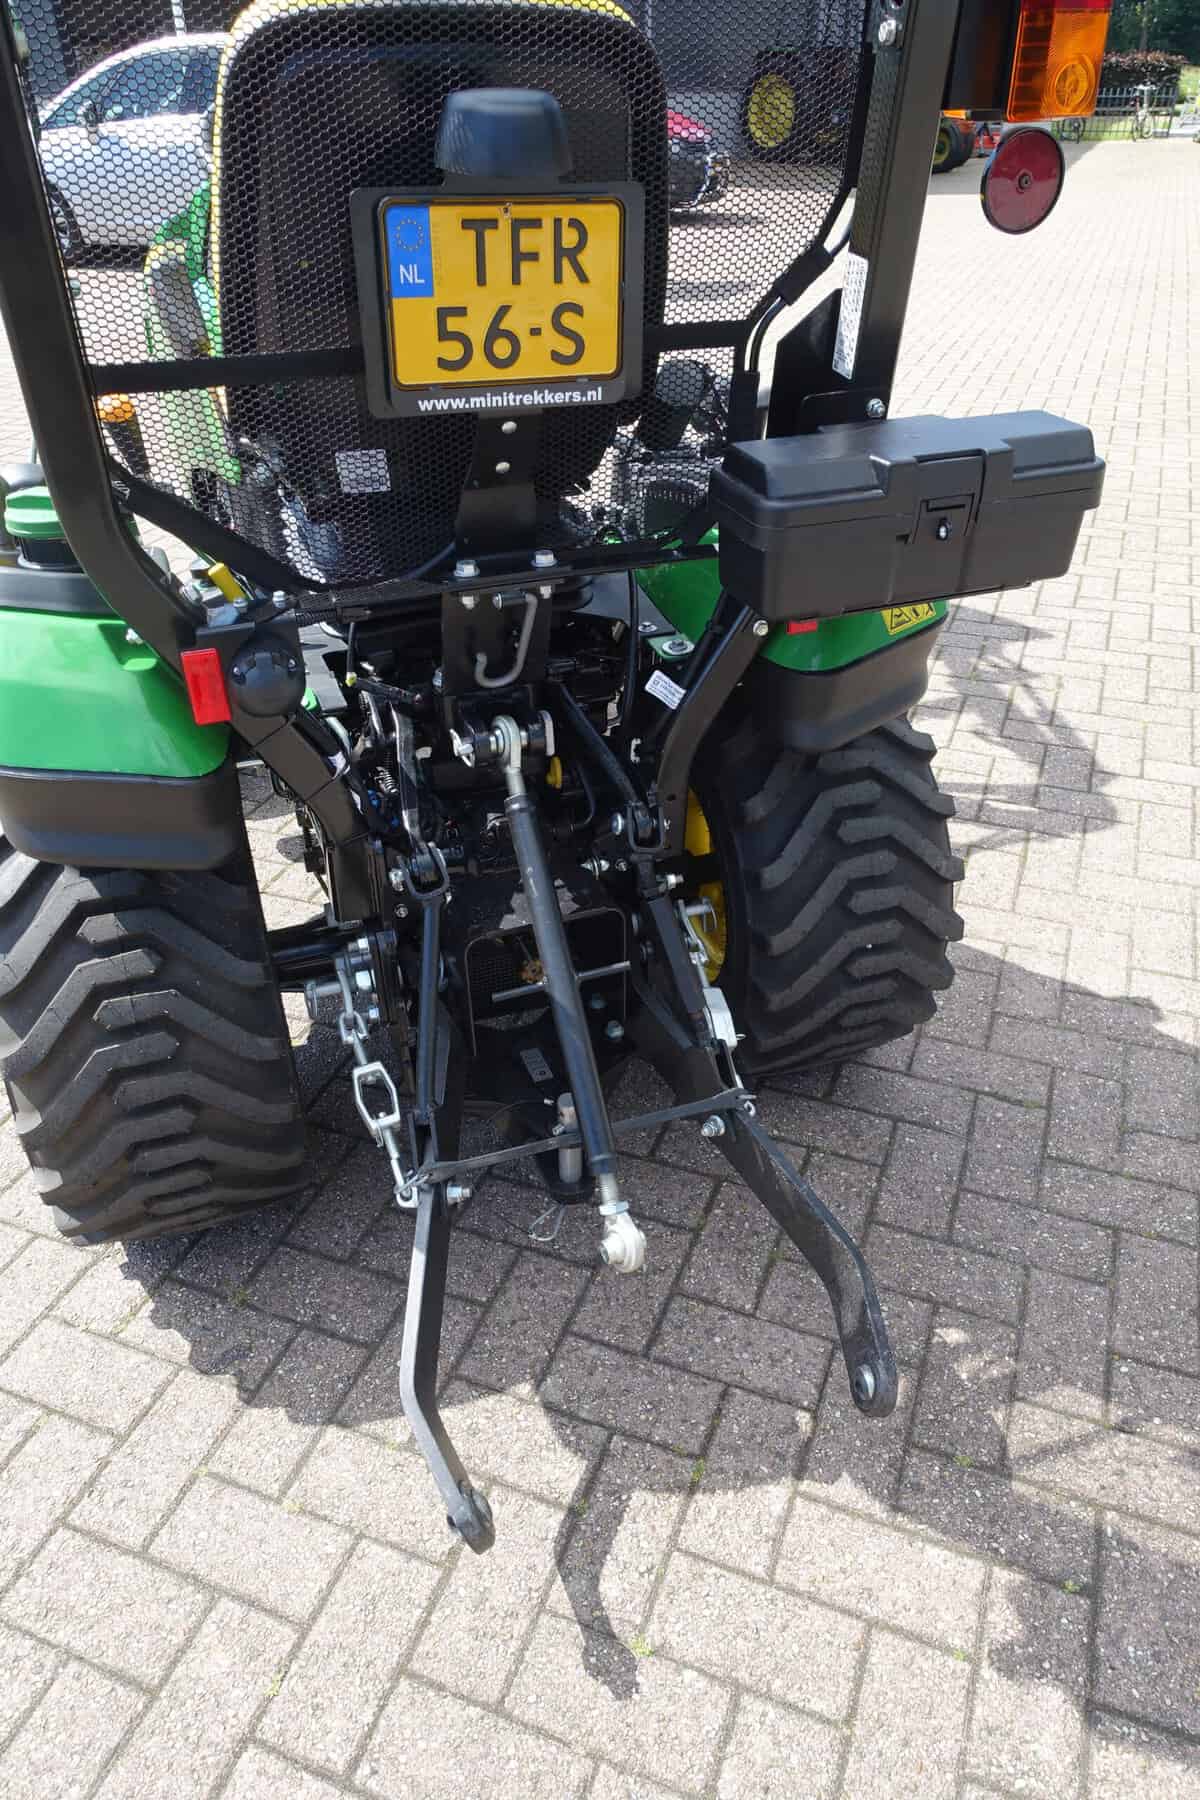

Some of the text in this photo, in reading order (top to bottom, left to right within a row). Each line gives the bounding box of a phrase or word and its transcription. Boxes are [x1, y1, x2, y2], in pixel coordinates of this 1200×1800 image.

[400, 264, 425, 284] NL
[461, 217, 590, 287] TFR
[436, 302, 585, 371] 56-S
[418, 386, 602, 411] www.minitrekkers.nl
